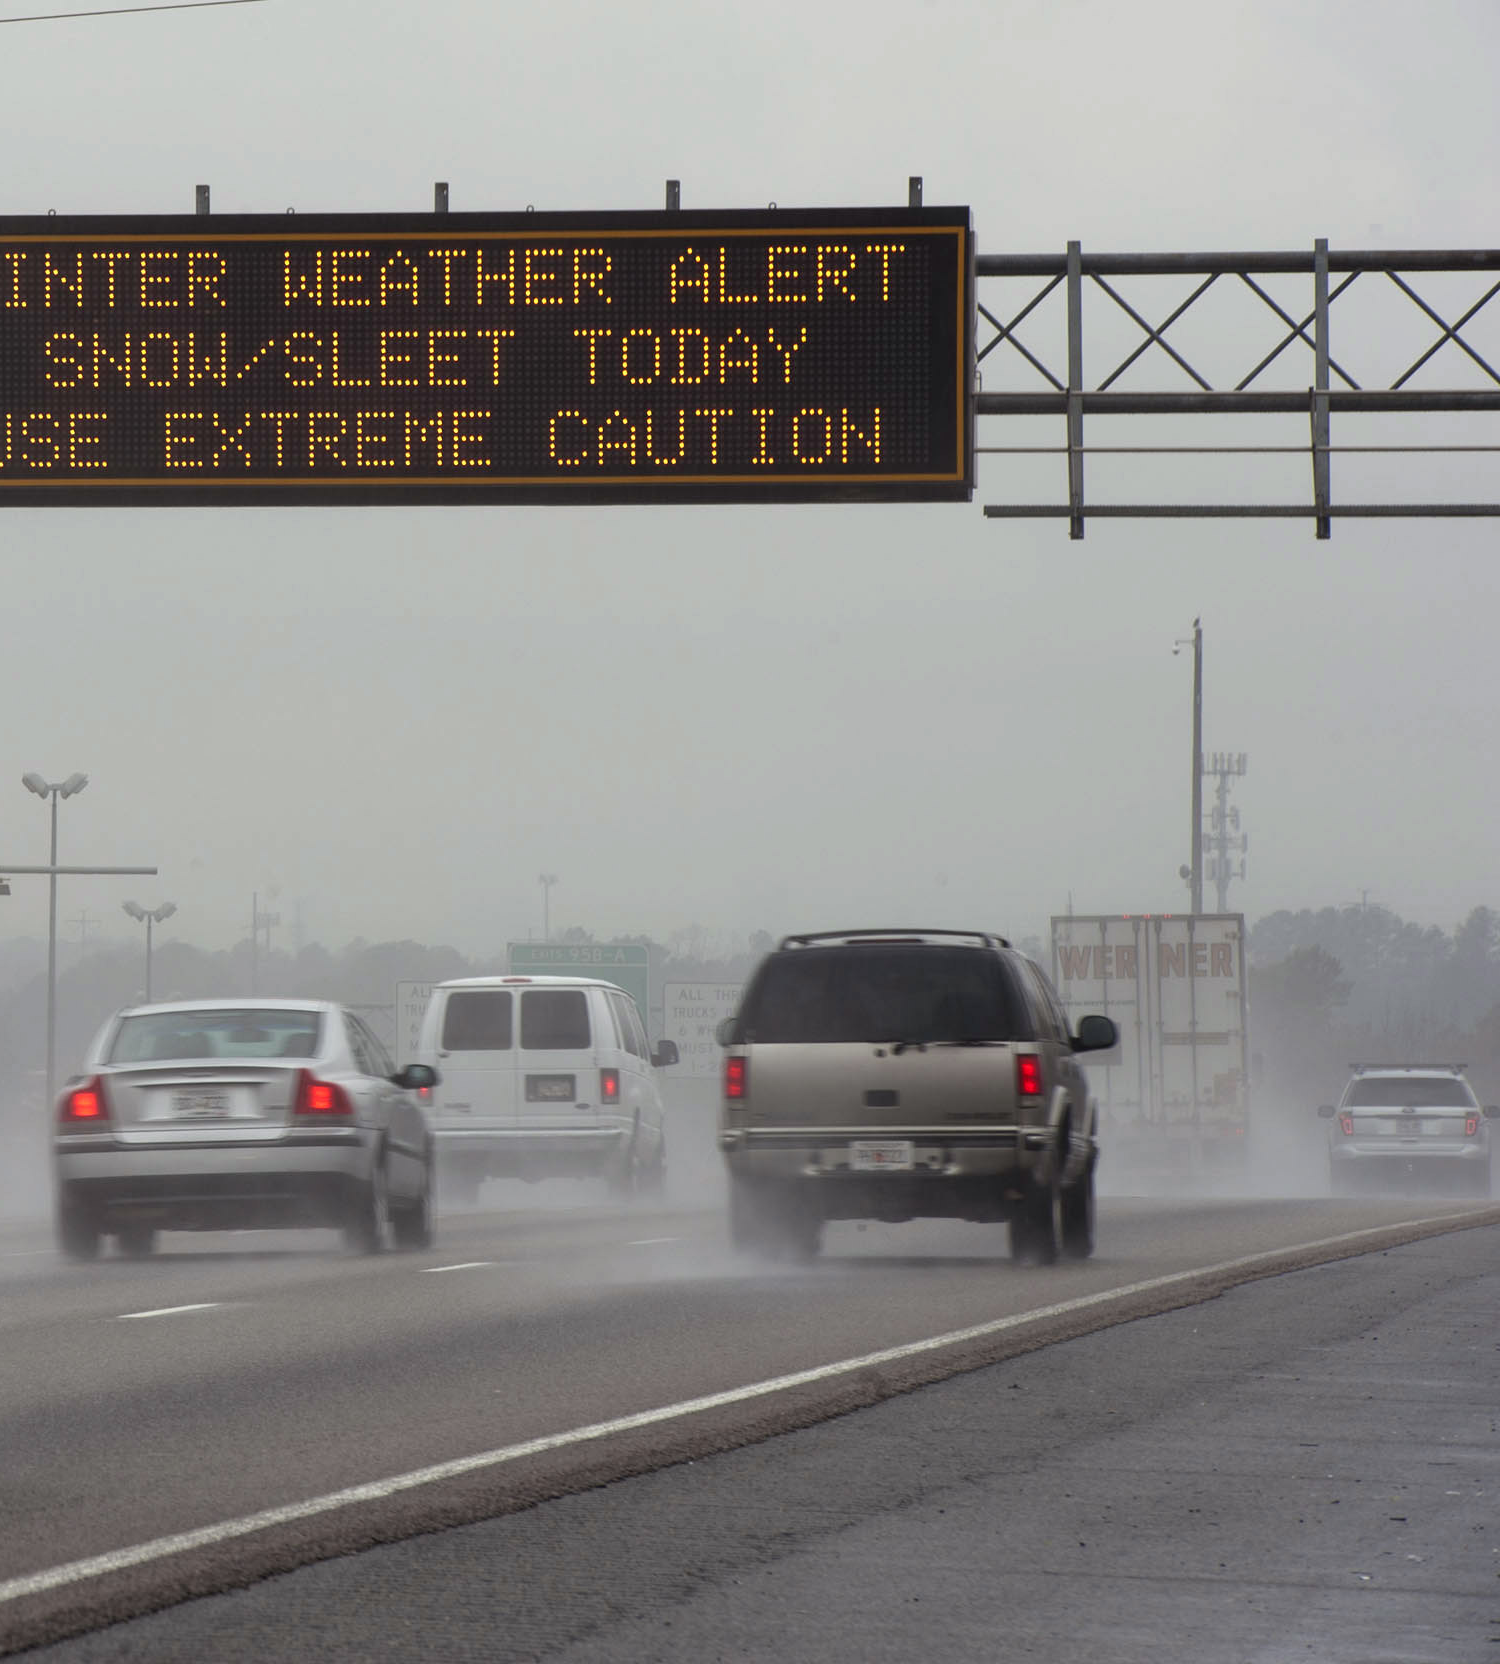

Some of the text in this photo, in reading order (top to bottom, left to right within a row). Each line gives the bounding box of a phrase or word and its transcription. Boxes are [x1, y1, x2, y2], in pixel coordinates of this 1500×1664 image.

[283, 248, 612, 308] WEATHER
[669, 244, 906, 305] ALERT
[45, 326, 808, 389] SNOW/SLEET TODAY
[164, 410, 491, 468] EXTREME
[548, 407, 881, 466] CAUTION
